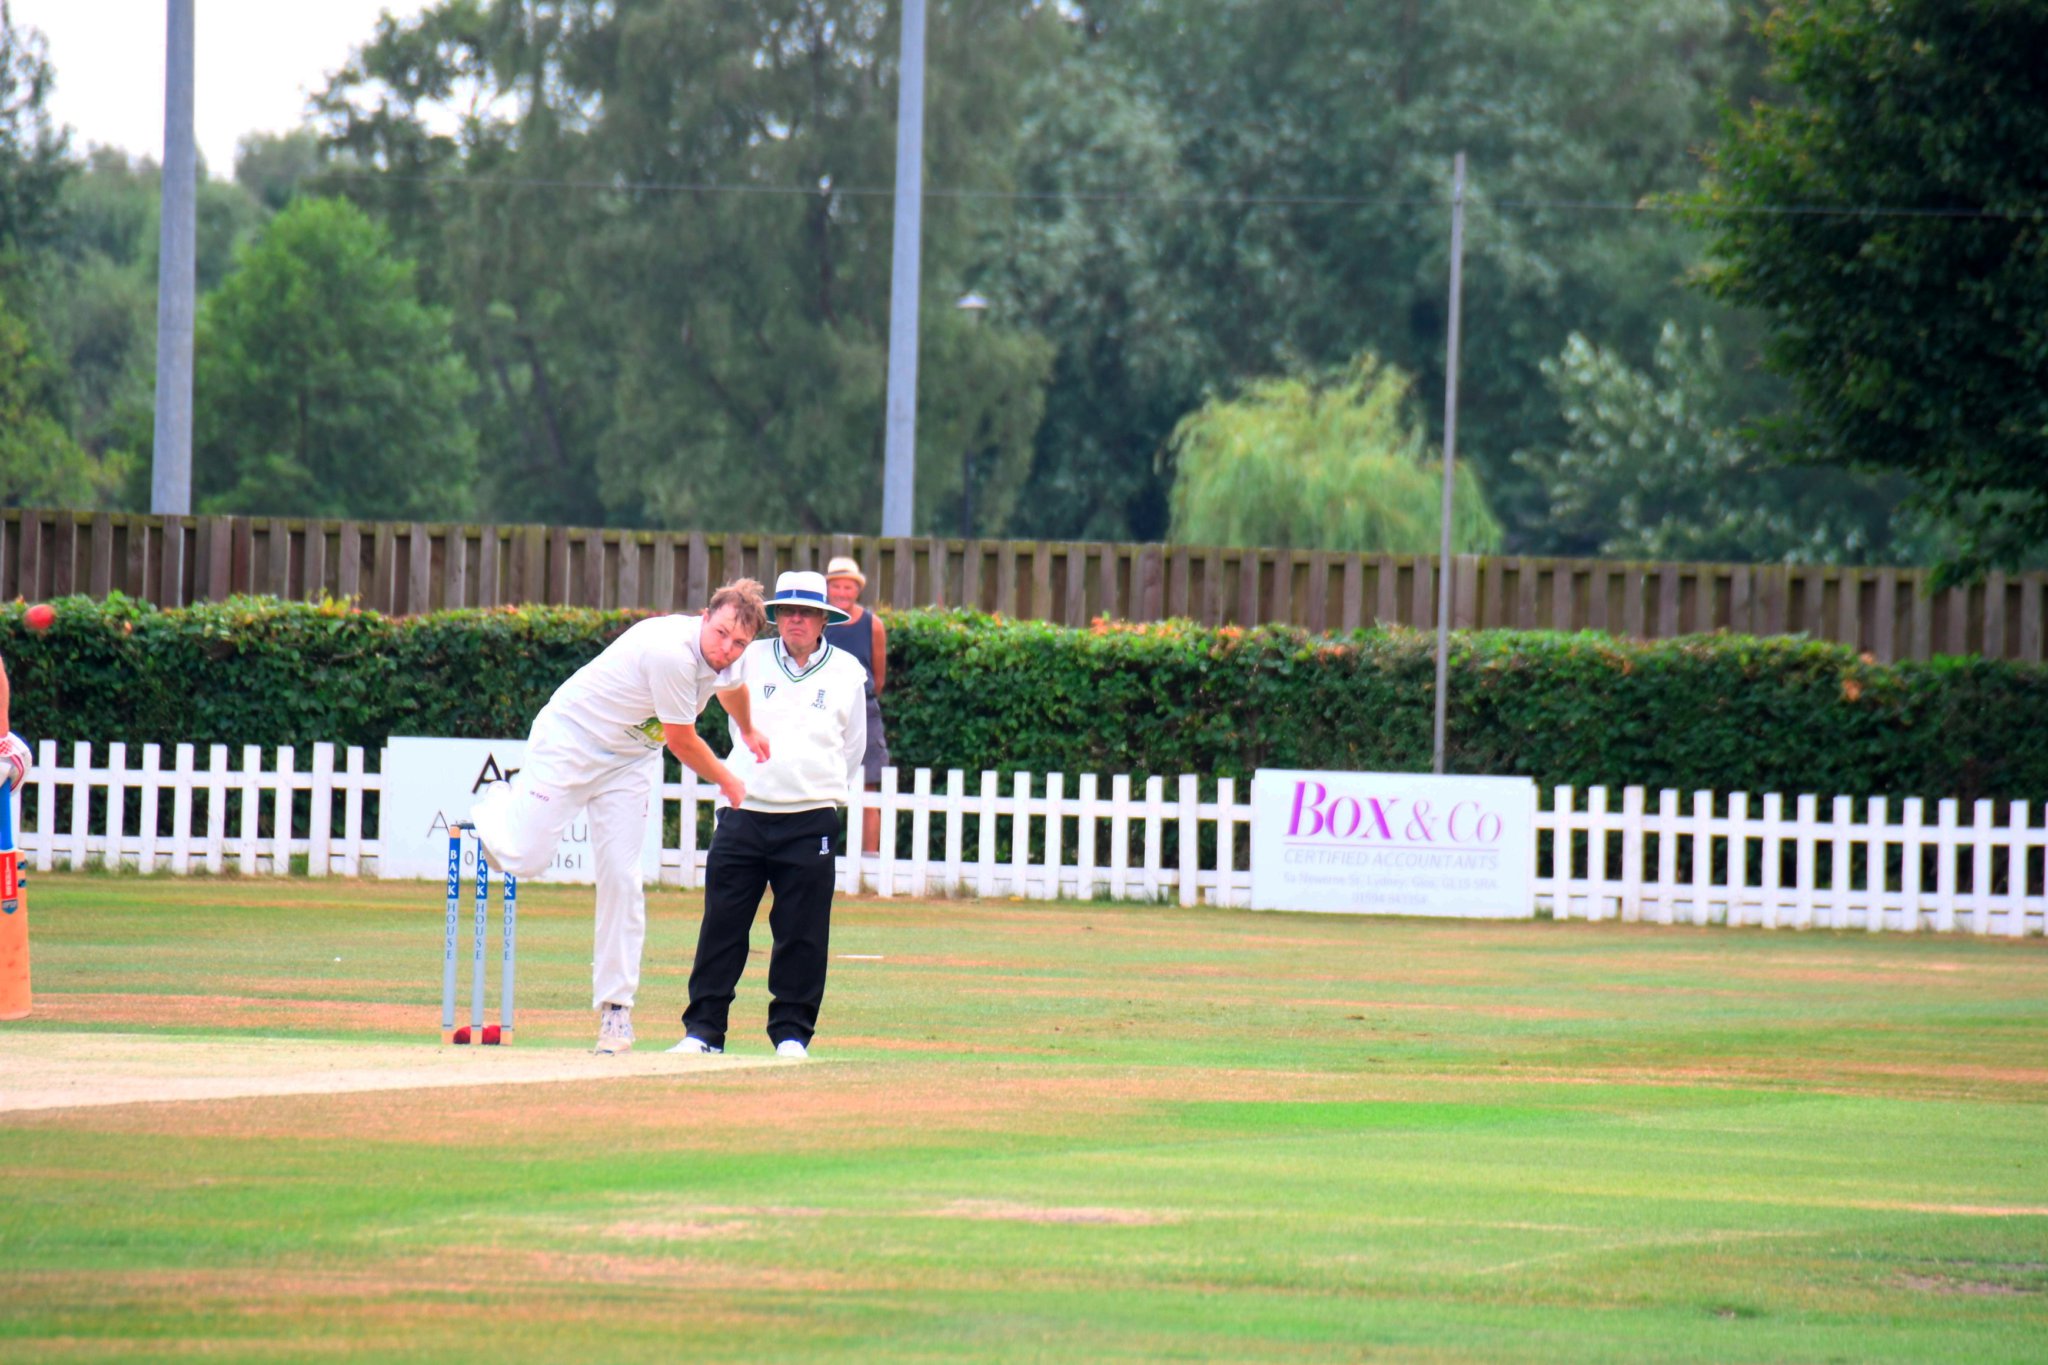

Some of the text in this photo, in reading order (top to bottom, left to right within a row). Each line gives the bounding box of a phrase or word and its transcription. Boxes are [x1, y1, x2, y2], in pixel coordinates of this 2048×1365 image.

[1405, 799, 1438, 842] &
[1284, 848, 1498, 870] CERTIFIED ACCOUNTANTS
[446, 849, 458, 961] BANK HOUSE
[475, 902, 485, 961] HOUSE
[504, 903, 513, 961] HOUSE
